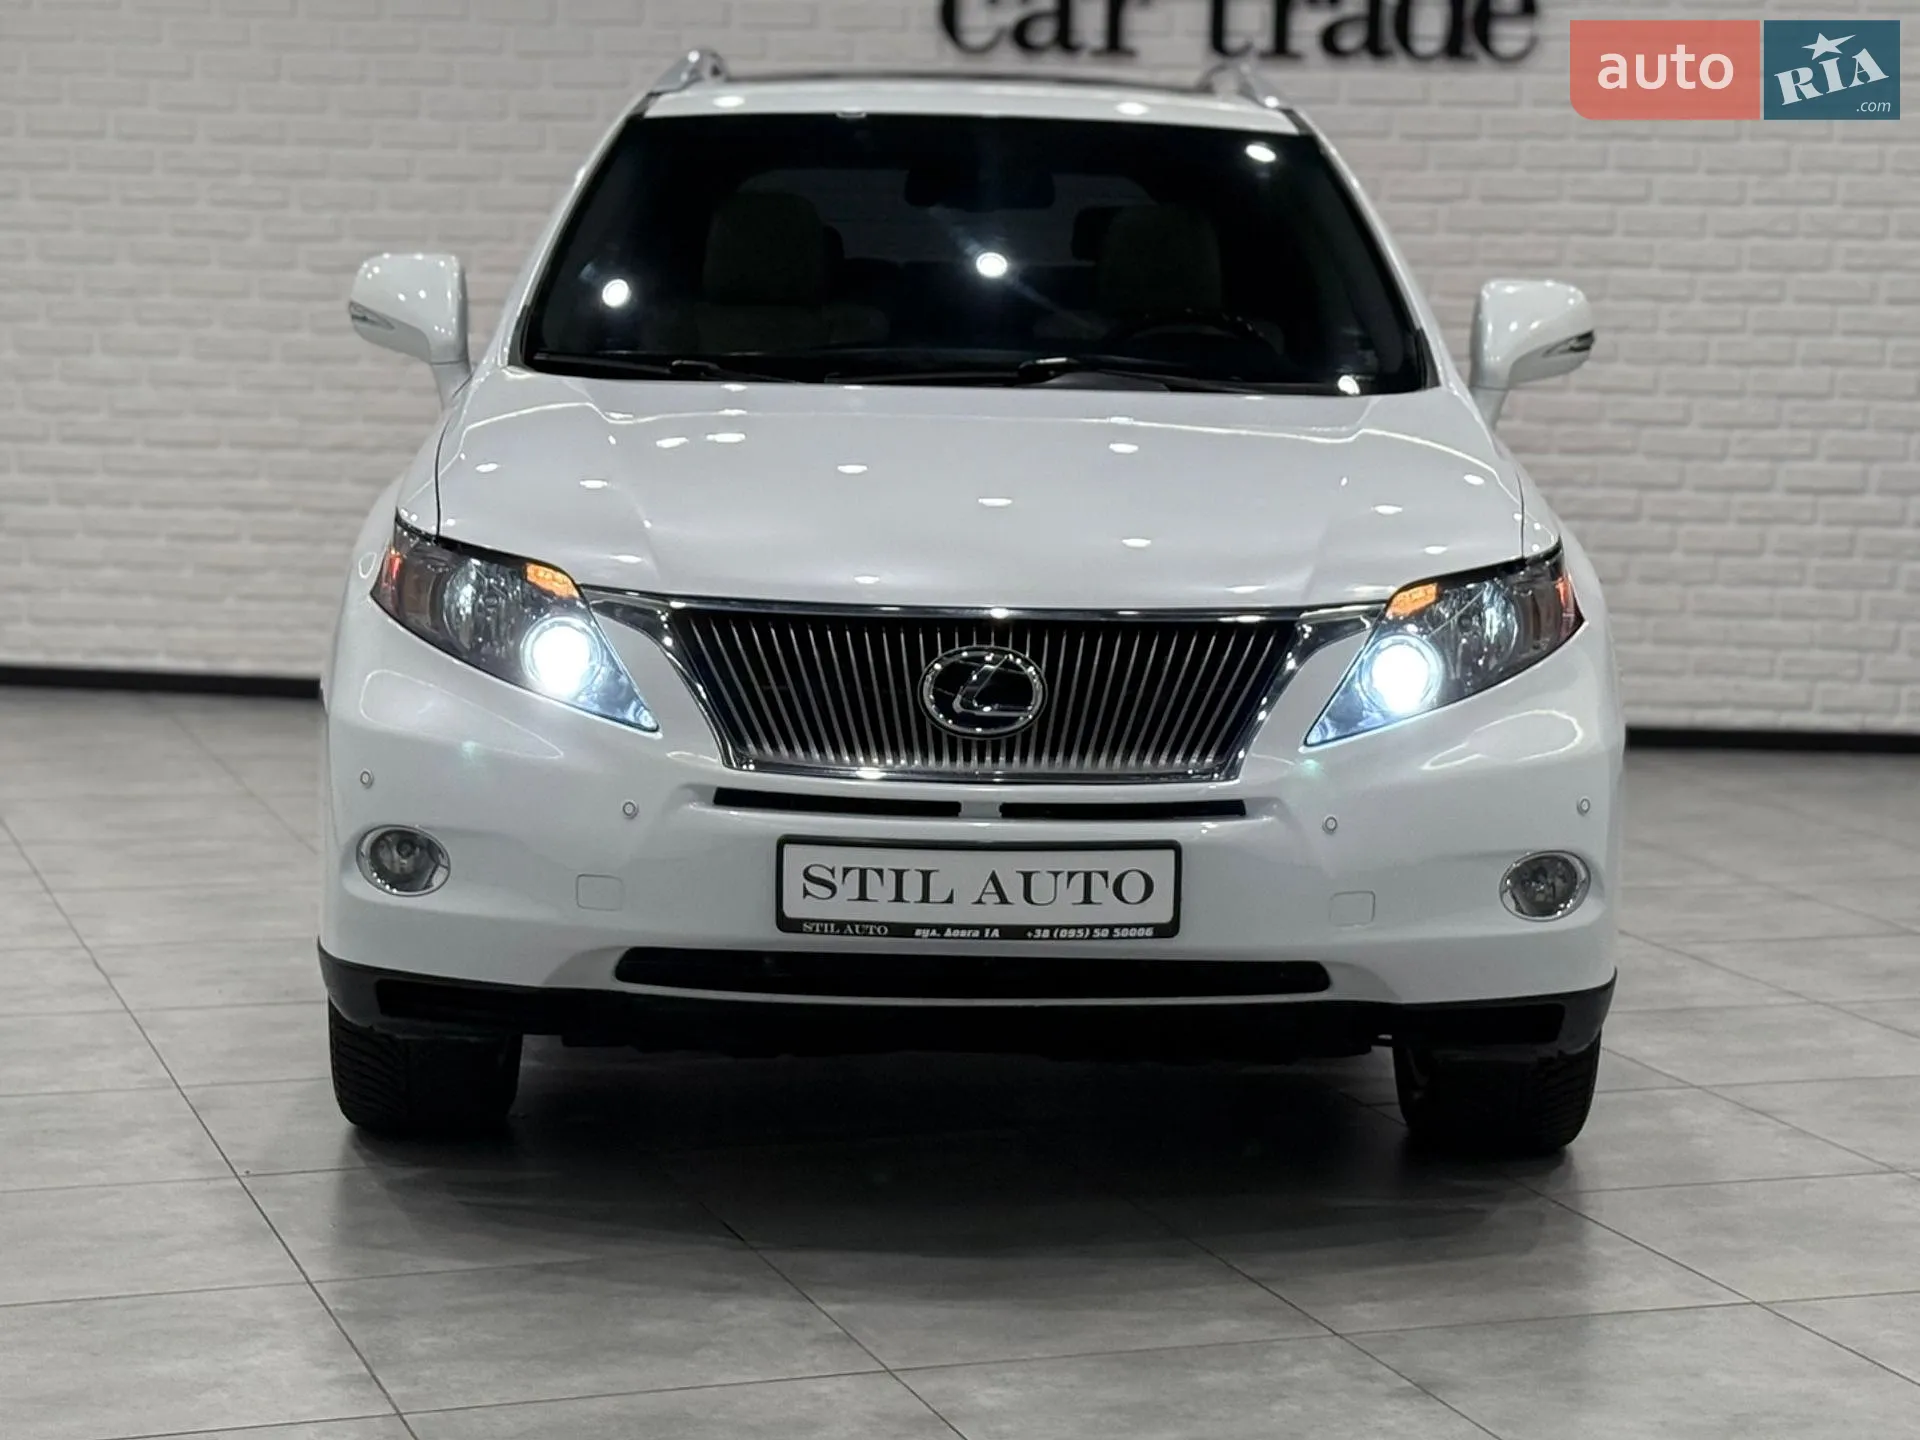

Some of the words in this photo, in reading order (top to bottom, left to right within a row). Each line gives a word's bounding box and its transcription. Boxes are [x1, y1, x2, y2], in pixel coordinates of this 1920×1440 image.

[939, 0, 1138, 57] car
[1207, 0, 1540, 63] trade
[801, 863, 955, 905] STIL
[971, 868, 1155, 907] AUTO
[802, 922, 840, 934] STIL
[843, 924, 889, 936] AUTO
[1026, 929, 1051, 939] +38
